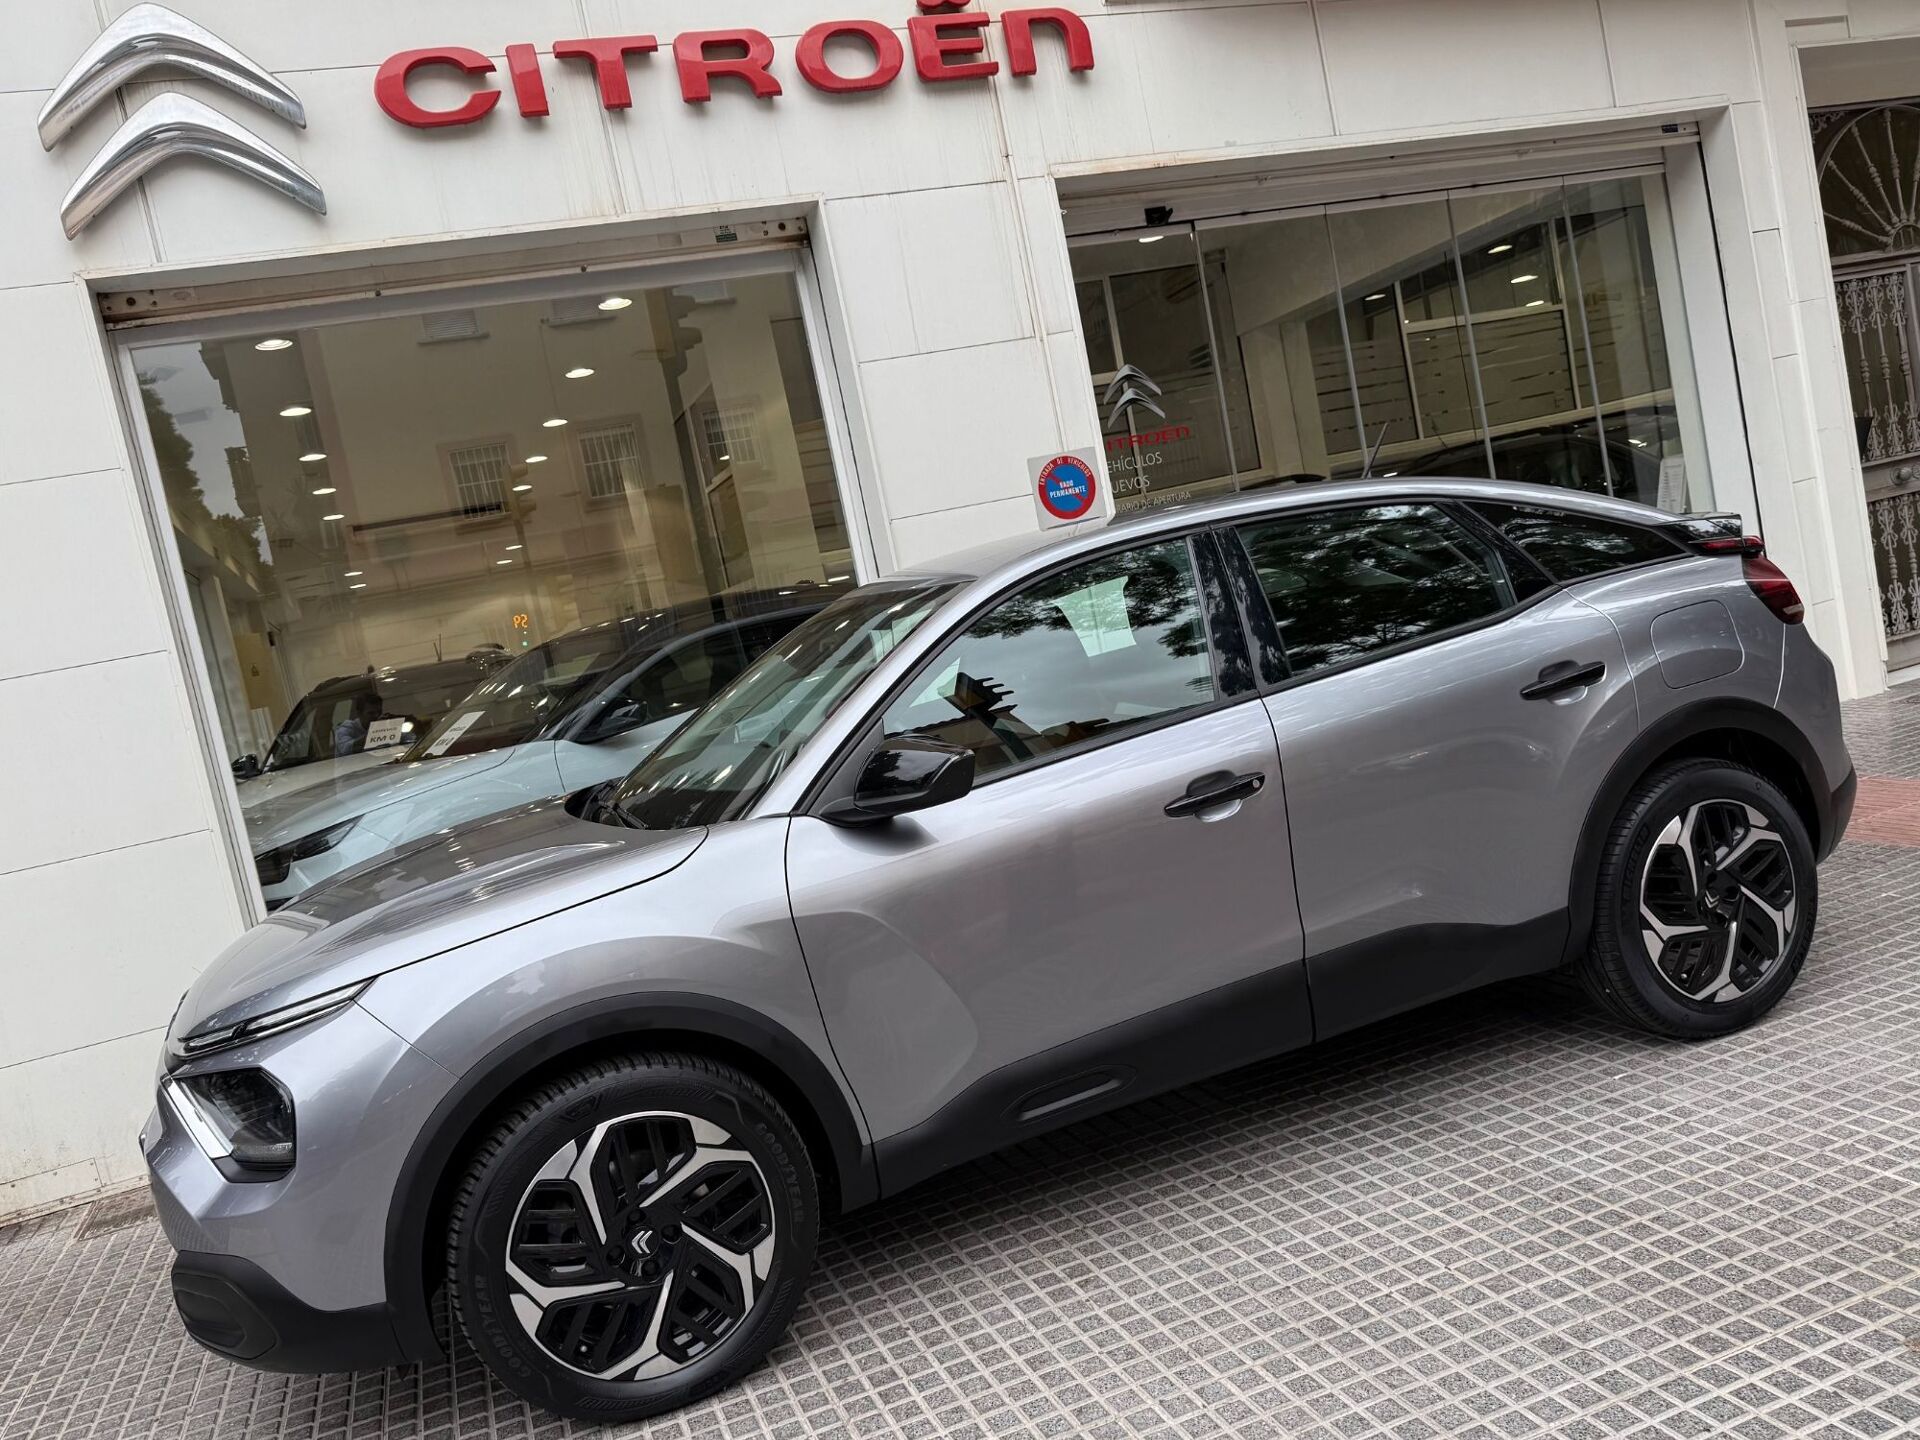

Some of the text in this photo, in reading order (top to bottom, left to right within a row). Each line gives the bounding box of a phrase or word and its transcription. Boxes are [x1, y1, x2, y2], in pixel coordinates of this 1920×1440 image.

[1107, 451, 1163, 474] EHÍCULOS
[1049, 485, 1087, 499] PERMANENTE
[1112, 475, 1150, 494] UEVOS
